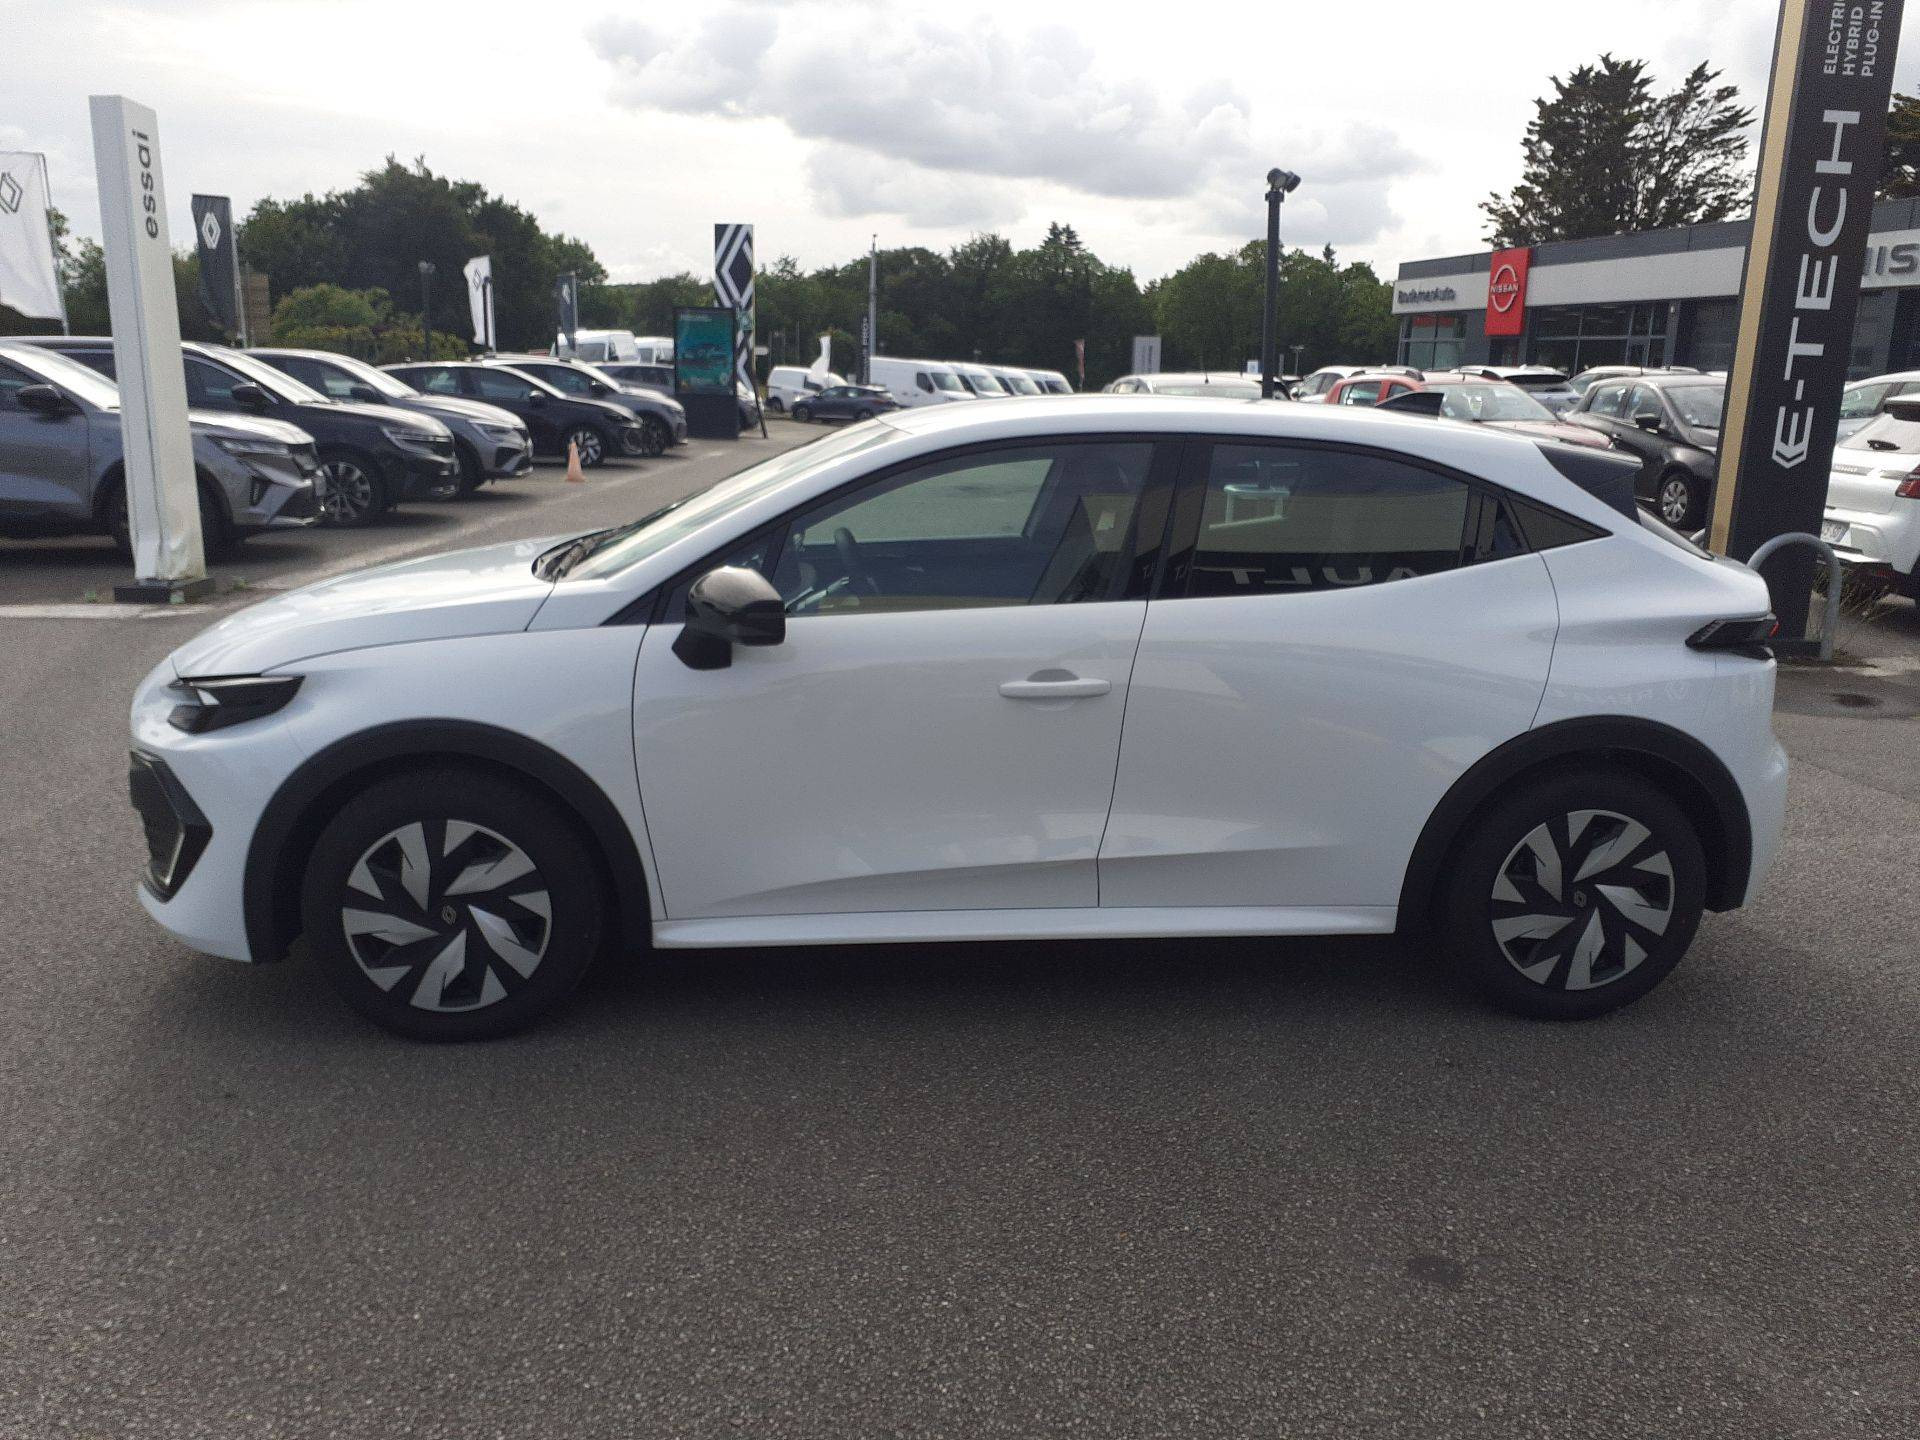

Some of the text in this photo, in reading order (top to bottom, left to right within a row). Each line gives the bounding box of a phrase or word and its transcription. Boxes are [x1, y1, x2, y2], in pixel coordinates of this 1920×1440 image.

[1823, 0, 1846, 75] ELECTRI
[1842, 6, 1864, 76] HYBRID
[1861, 1, 1884, 77] PLUG-IN
[132, 129, 159, 239] essai
[1490, 284, 1519, 293] NISSAN
[1771, 110, 1860, 469] E-TECH
